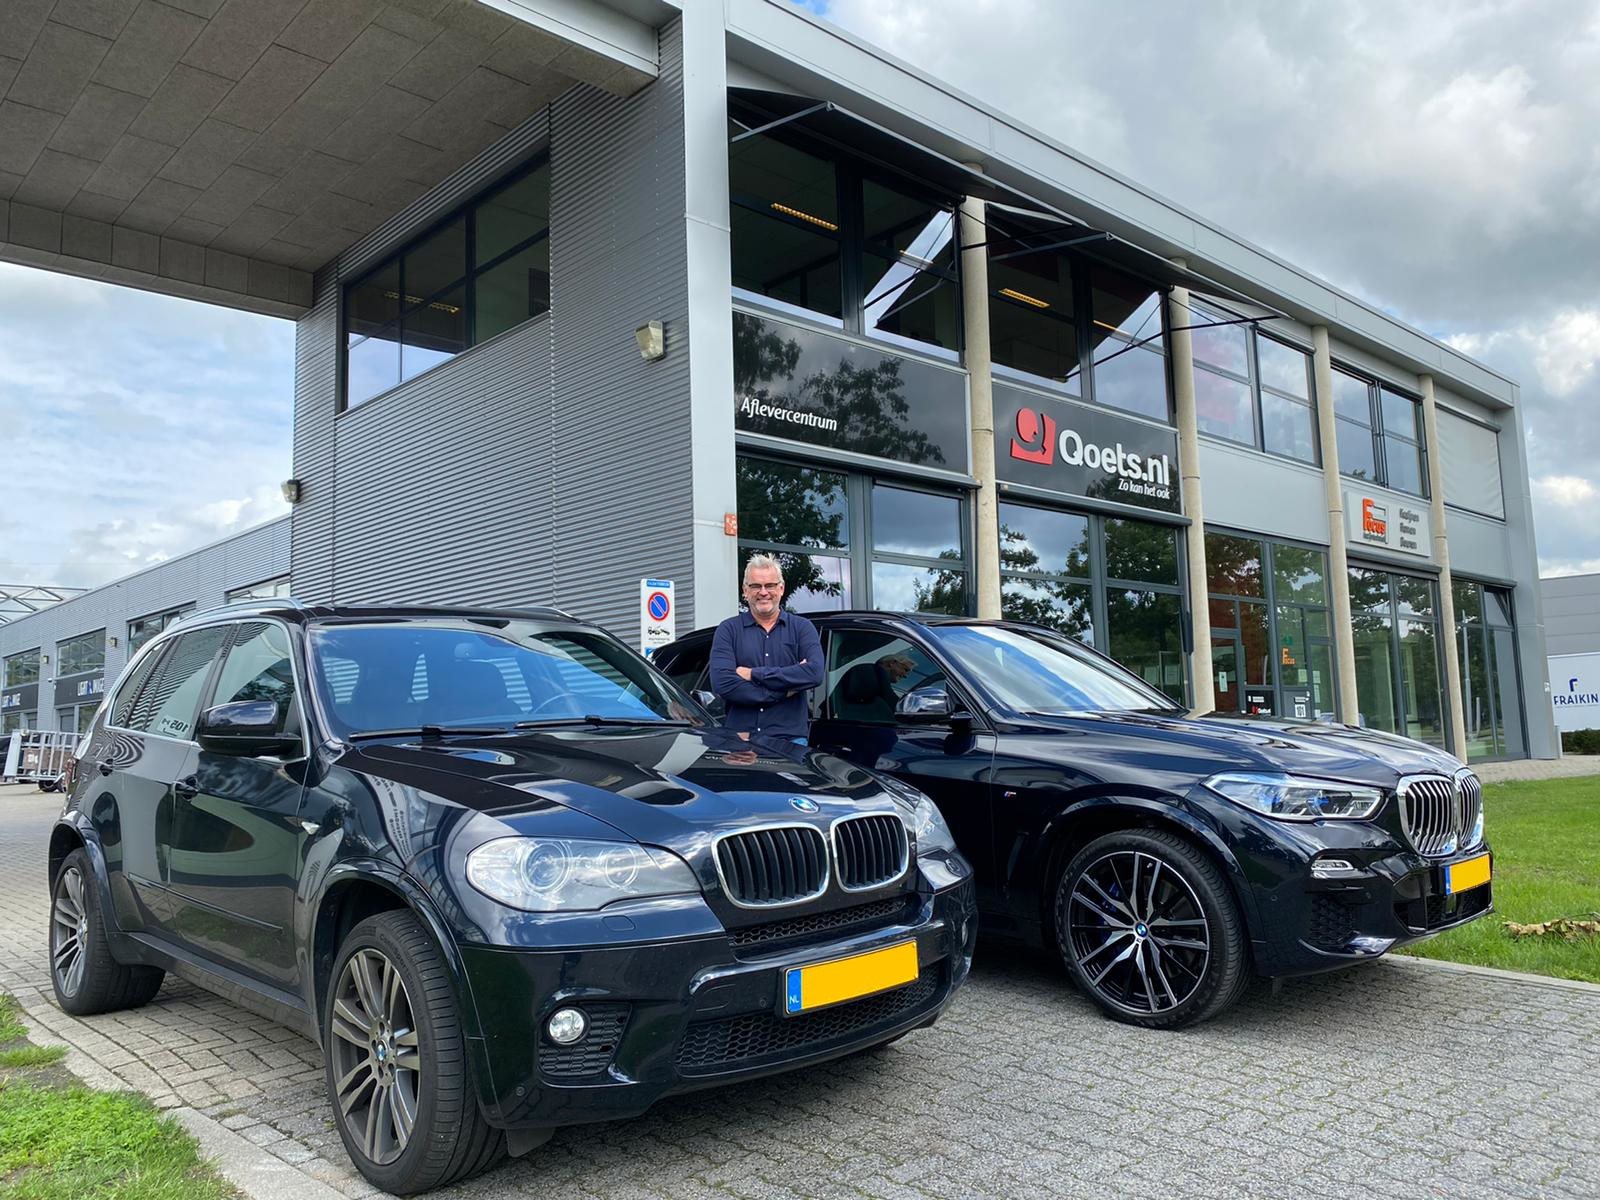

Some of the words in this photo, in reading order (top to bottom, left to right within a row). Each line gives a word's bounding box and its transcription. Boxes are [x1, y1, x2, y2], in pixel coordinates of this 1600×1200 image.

[740, 397, 838, 431] Aflevercentrum
[1059, 429, 1170, 486] Qoets.nl
[1118, 478, 1129, 491] Zo
[1130, 480, 1144, 494] kan
[1144, 483, 1156, 497] het
[1156, 487, 1170, 499] ook
[1553, 693, 1599, 705] FRAIKIN
